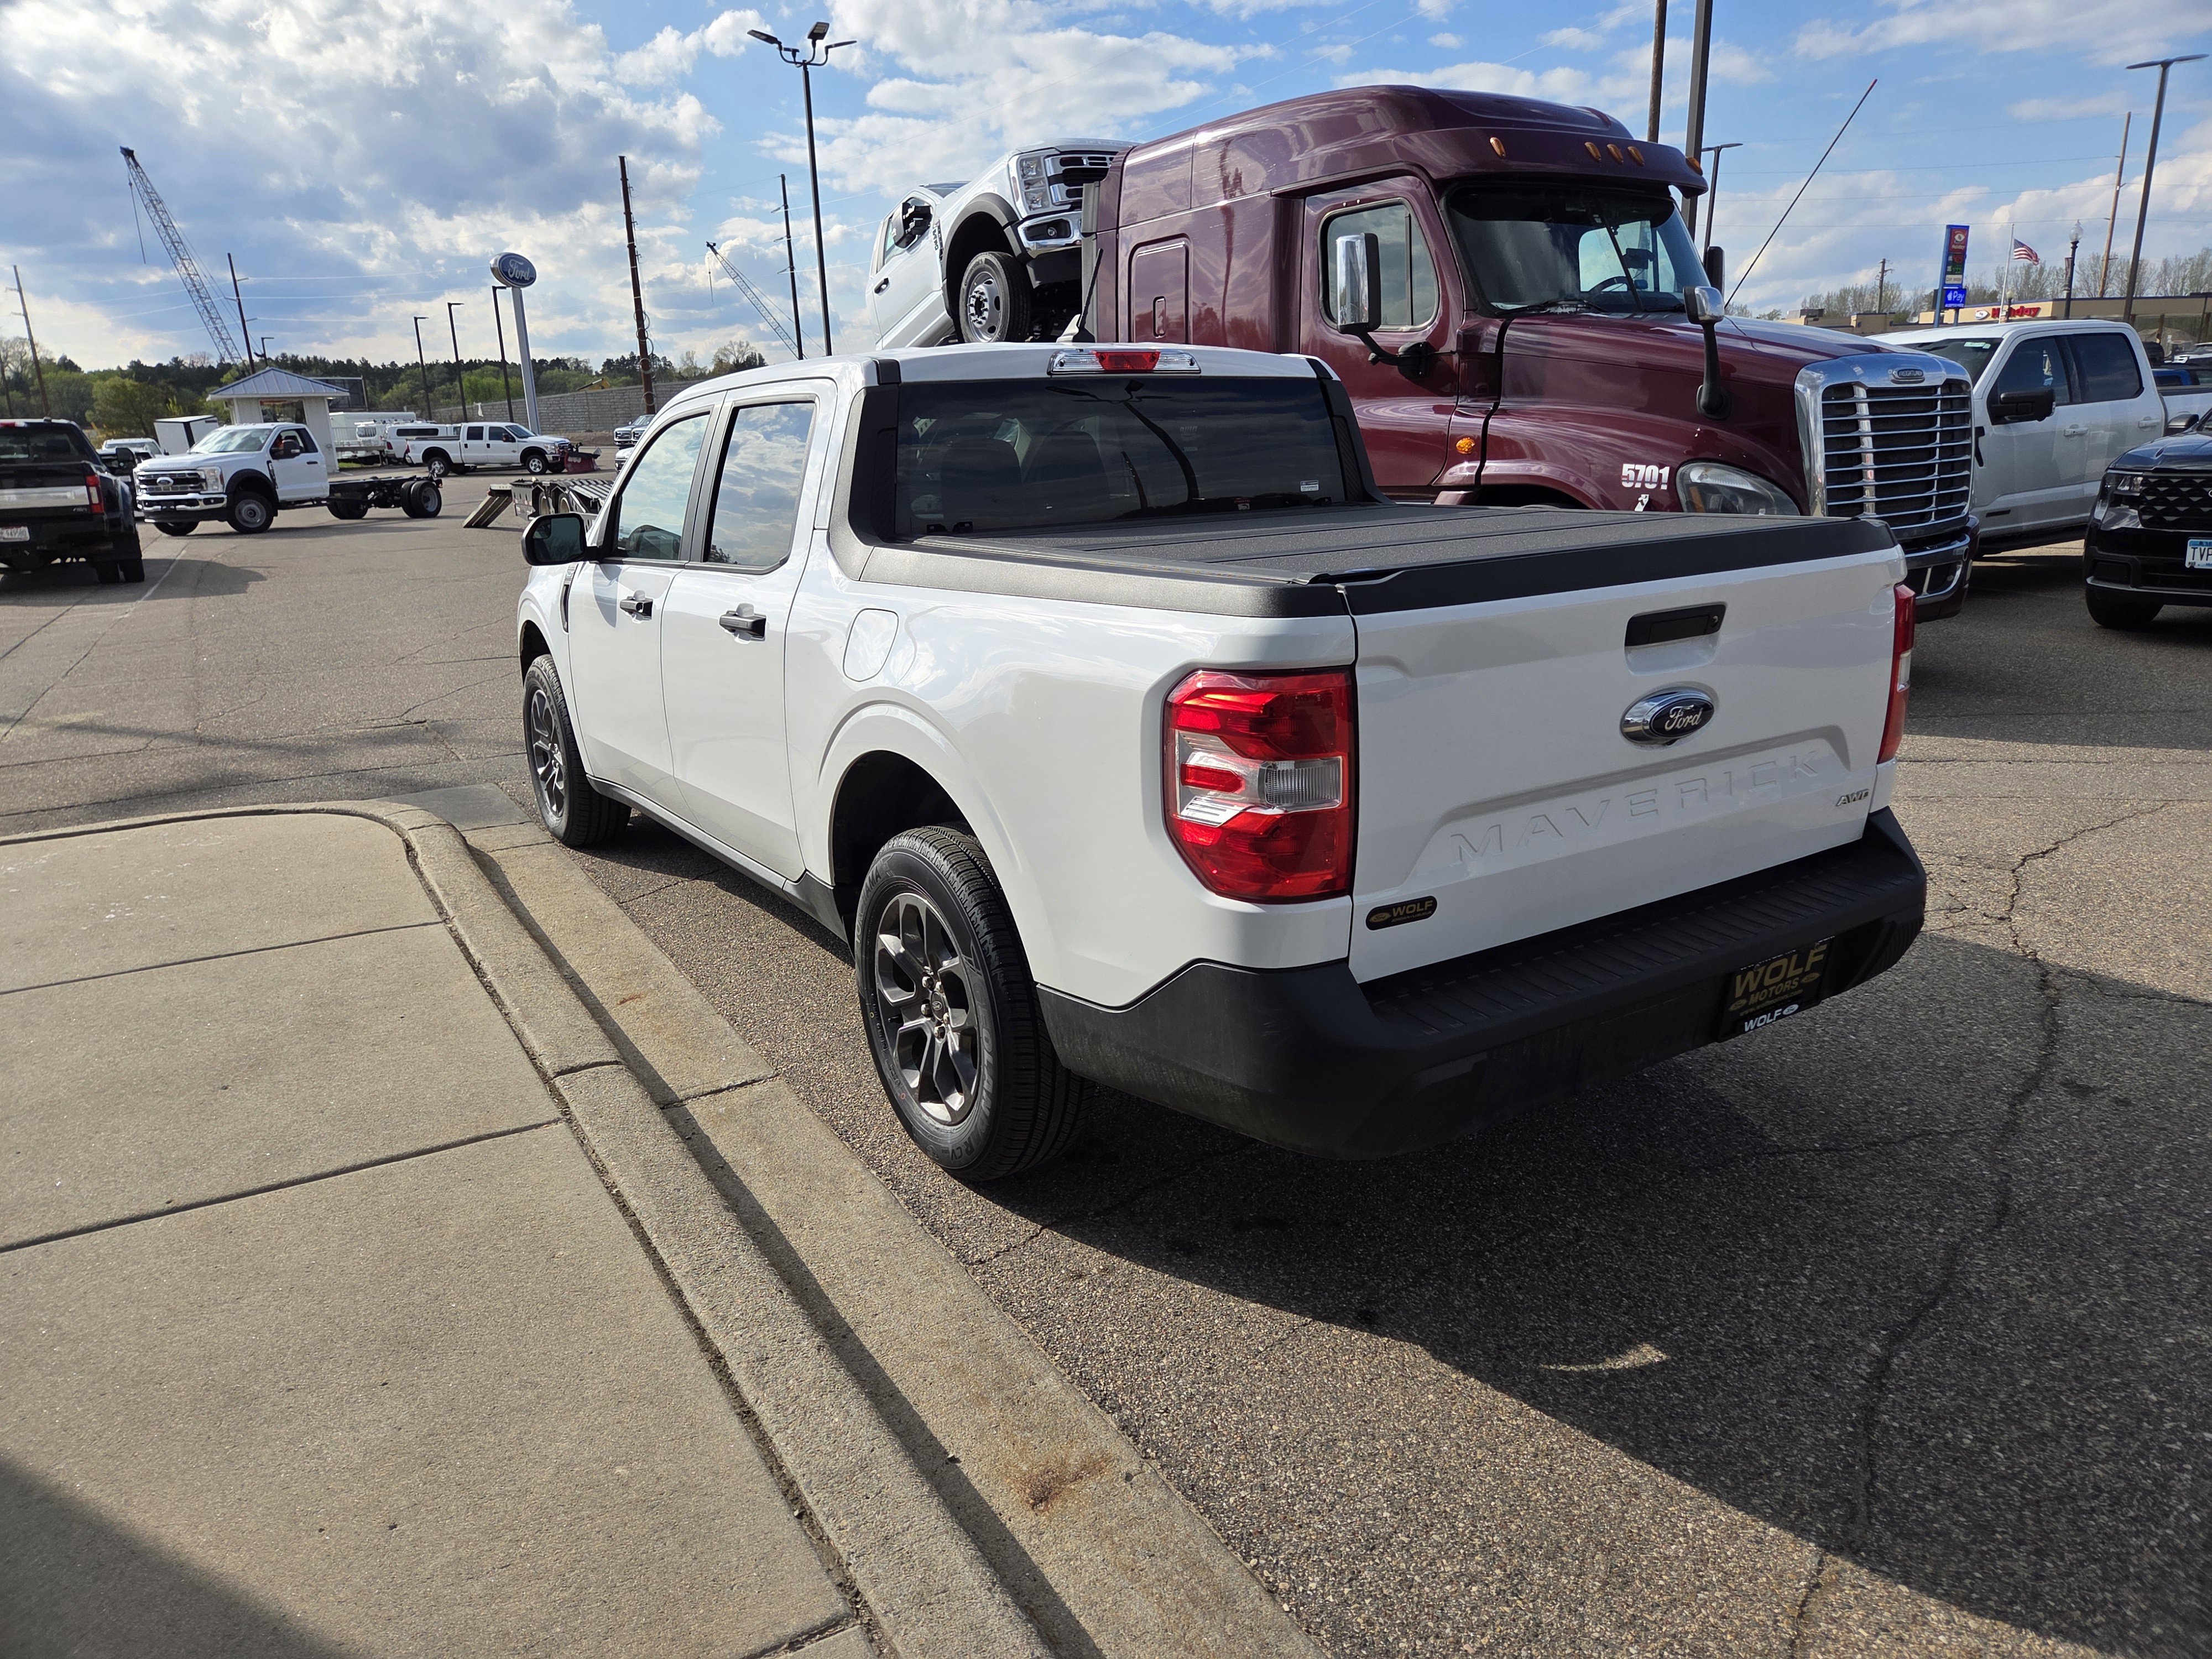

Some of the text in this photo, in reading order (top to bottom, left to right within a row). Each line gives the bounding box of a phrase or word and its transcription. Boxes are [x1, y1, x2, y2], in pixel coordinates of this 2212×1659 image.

[508, 259, 531, 281] Ford
[1953, 290, 1965, 303] Pay
[1621, 463, 1670, 490] 5701
[1664, 704, 1704, 731] Ford
[1449, 749, 1820, 868] MAVERICK
[1835, 788, 1870, 807] AWD
[1392, 900, 1433, 917] WOLF
[1734, 944, 1828, 998] WOLF
[1748, 977, 1800, 1005] MOTORS
[1744, 1008, 1782, 1032] WOLF
